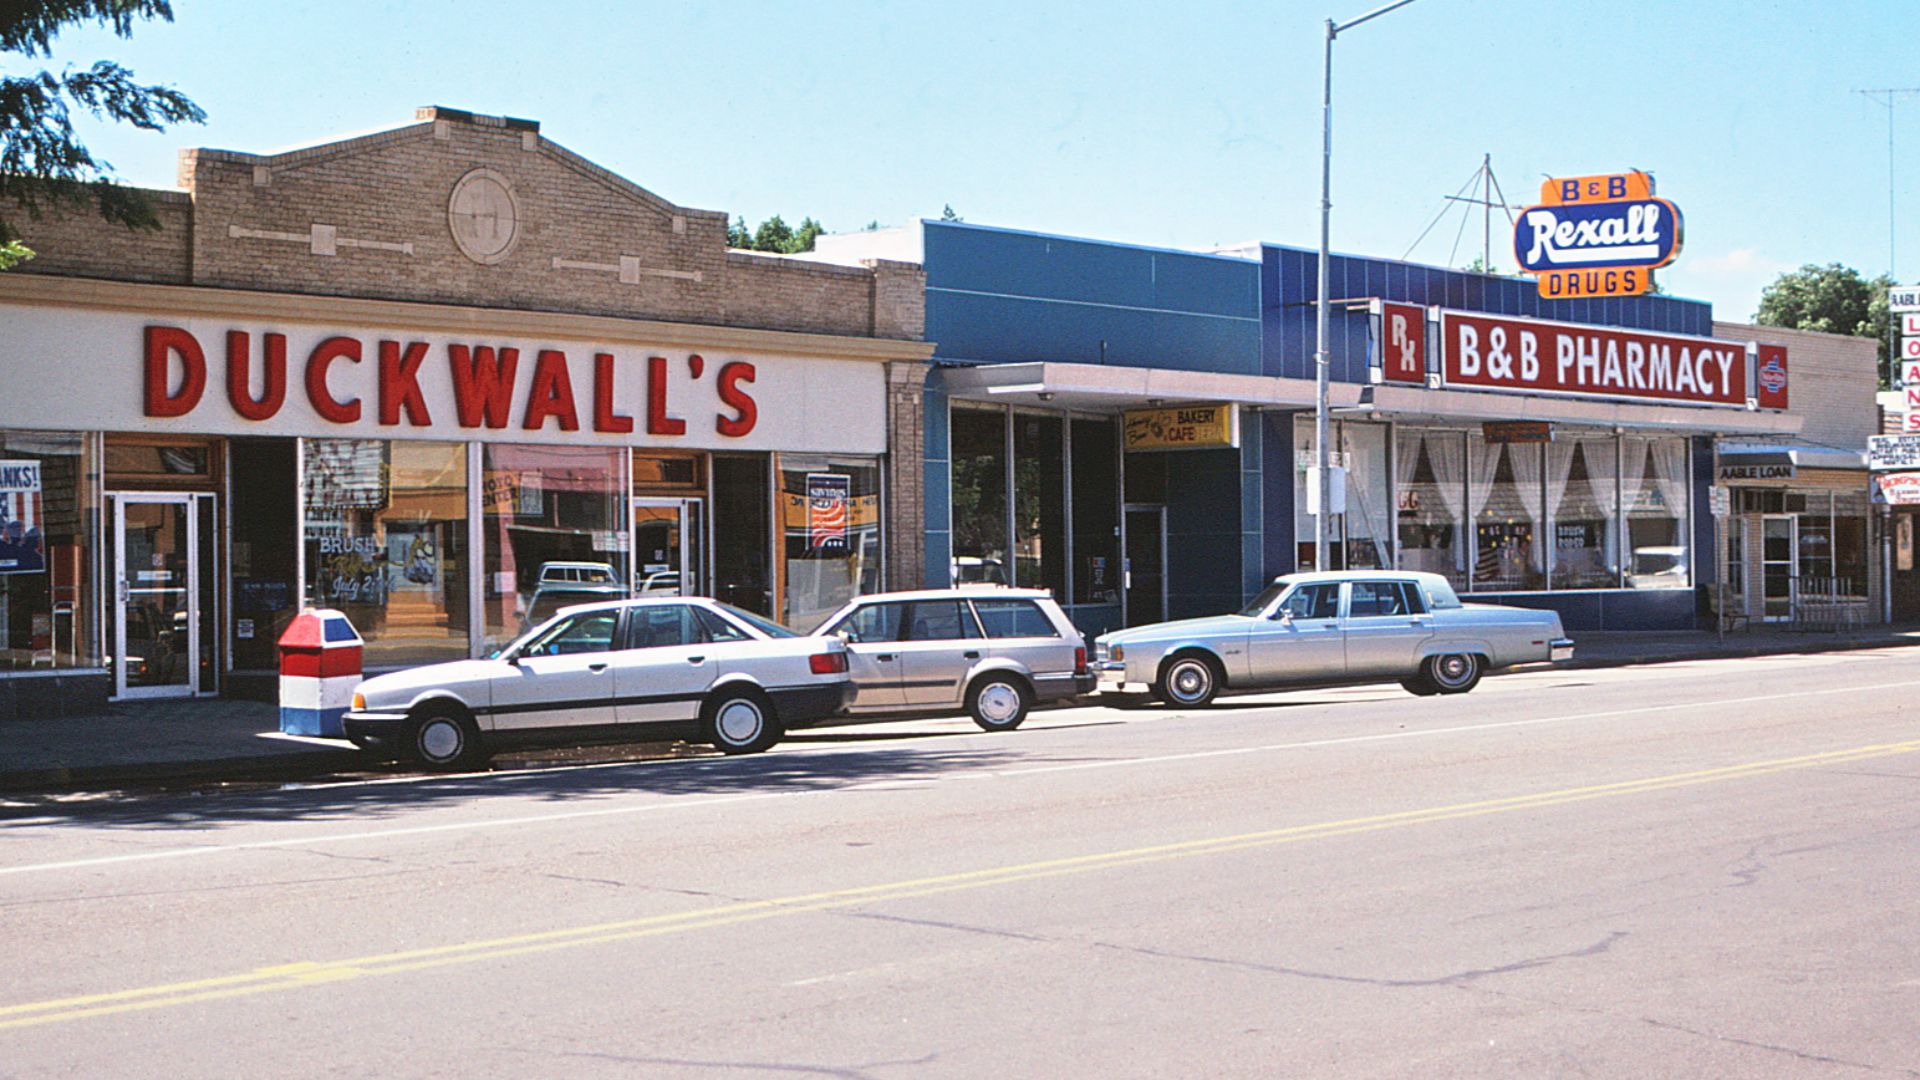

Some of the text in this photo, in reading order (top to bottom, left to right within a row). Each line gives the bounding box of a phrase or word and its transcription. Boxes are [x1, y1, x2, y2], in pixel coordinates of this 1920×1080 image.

[1526, 203, 1660, 265] Rexall
[1549, 270, 1637, 295] DRUGS
[1891, 293, 1920, 306] AABL
[1556, 333, 1735, 397] PHARMACY
[143, 325, 758, 437] DUCKWALL'S
[1177, 409, 1216, 424] BAKERY
[1168, 427, 1196, 441] CAFE
[1721, 466, 1792, 480] AABLE LOAN
[320, 537, 376, 554] BRUSH
[330, 575, 361, 601] July
